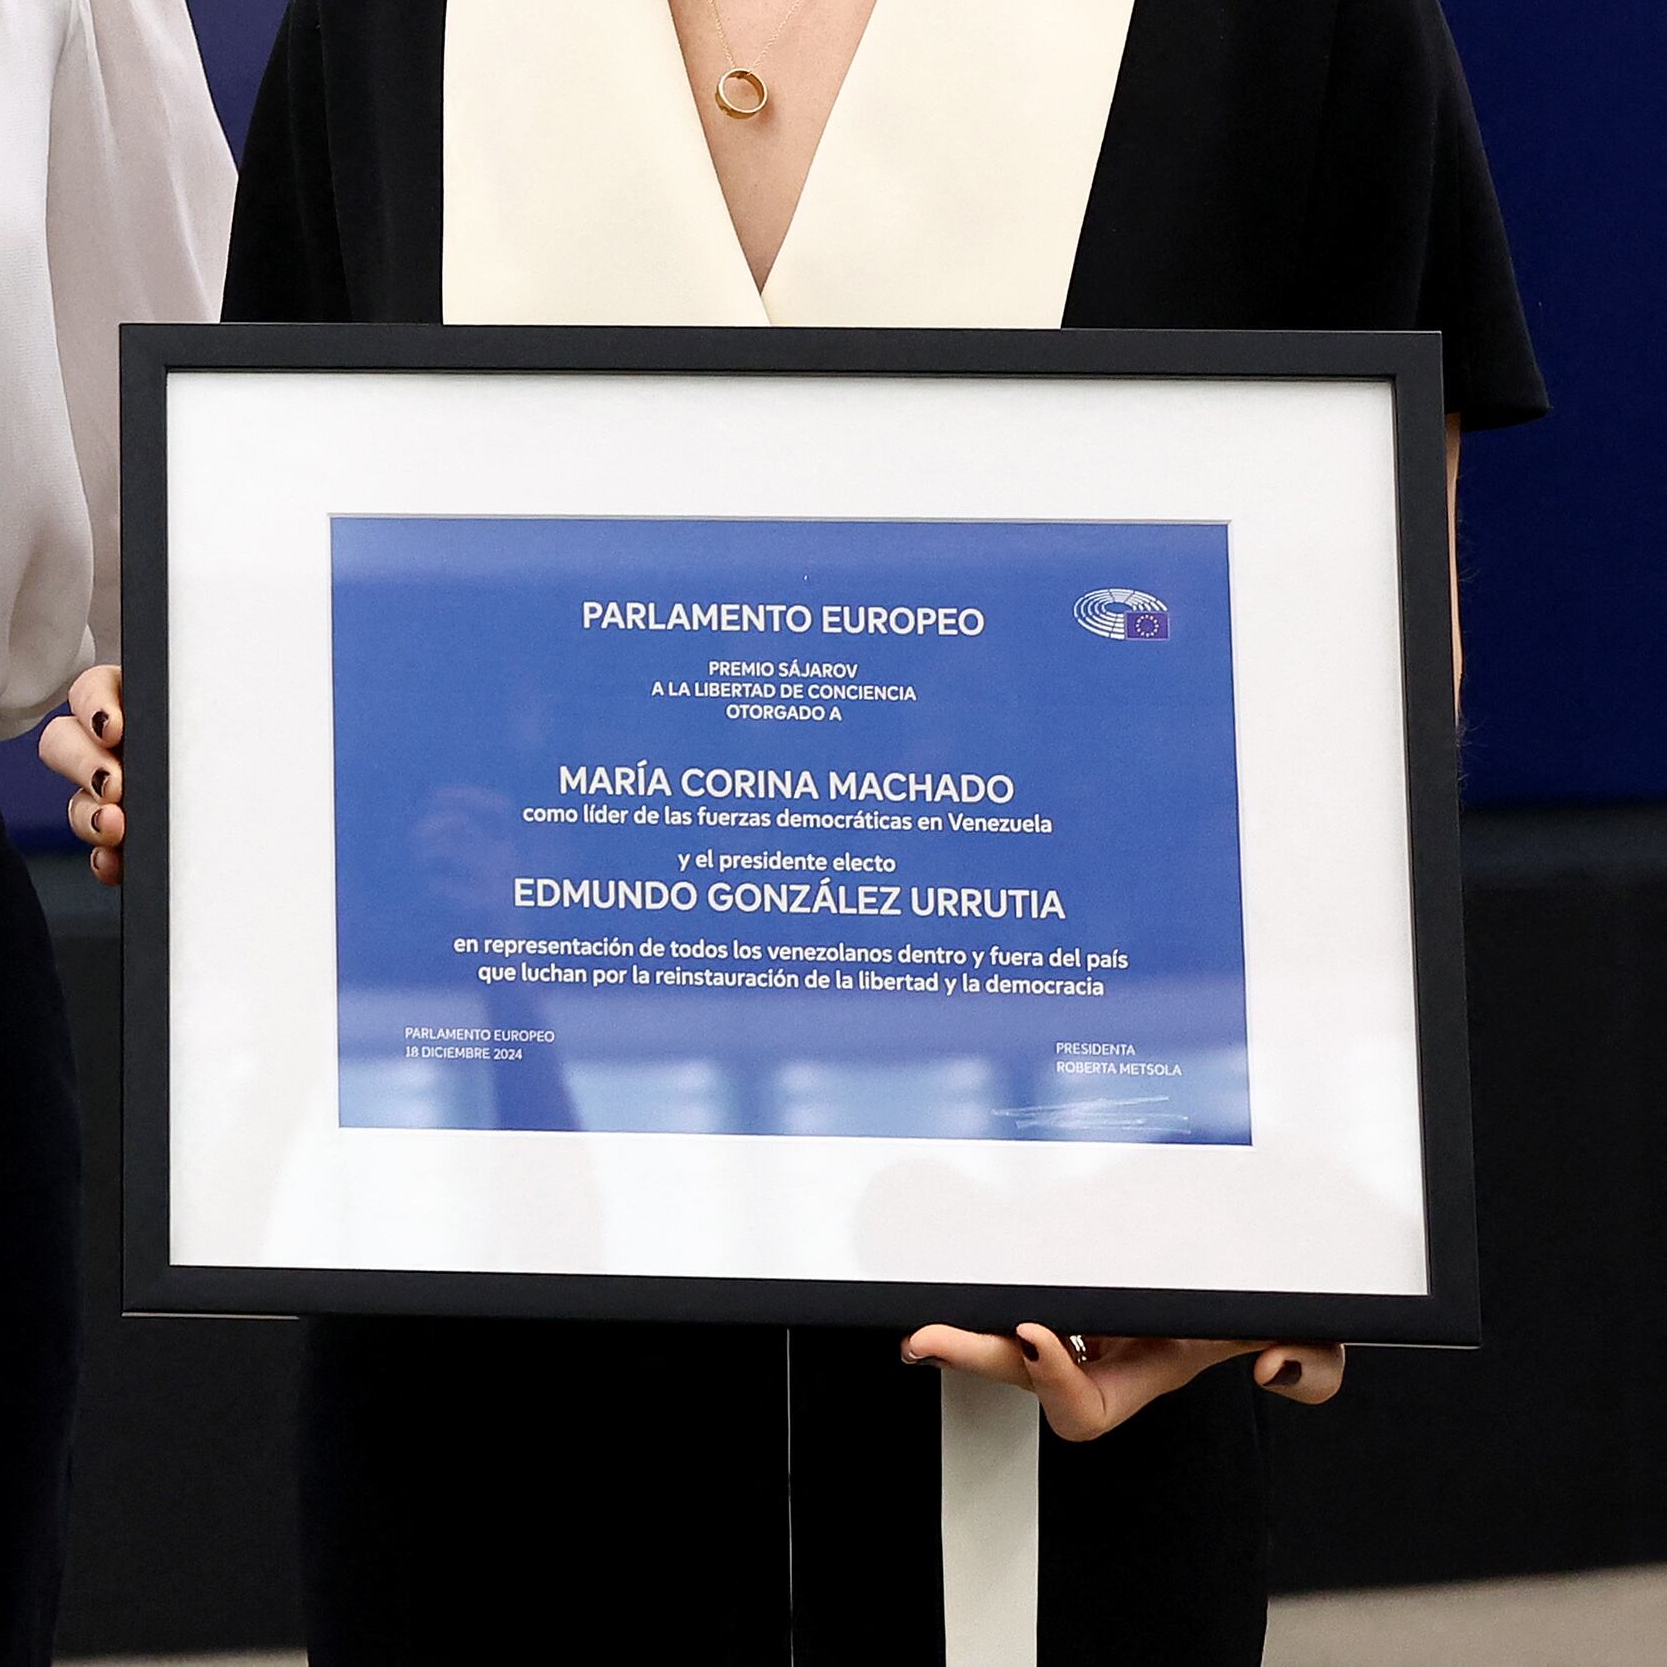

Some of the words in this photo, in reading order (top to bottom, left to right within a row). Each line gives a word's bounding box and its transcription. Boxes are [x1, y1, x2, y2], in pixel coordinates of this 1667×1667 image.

[582, 600, 812, 633] PARLAMENTO
[821, 604, 984, 636] EUROPEO
[708, 660, 774, 677] PREMIO
[777, 657, 858, 679] SÁJAROV
[650, 680, 665, 696] A
[667, 680, 691, 697] LA
[693, 681, 776, 698] LIBERTAD
[779, 682, 804, 699] DE
[807, 683, 917, 701] CONCIENCIA
[725, 703, 826, 721] OTORGADO
[828, 705, 842, 721] A
[558, 758, 672, 796] MARÍA
[680, 767, 819, 800] CORINA
[828, 770, 1014, 804] MACHADO
[522, 807, 578, 823] como
[582, 802, 629, 824] líder
[632, 804, 660, 825] de
[663, 804, 693, 825] las
[695, 805, 772, 827] fuerzas
[775, 807, 913, 830] democráticas
[916, 815, 943, 831] en
[947, 811, 1053, 833] Venezuela
[677, 852, 691, 872] y
[694, 848, 714, 868] el
[718, 849, 828, 873] presidente
[831, 851, 896, 873] electo
[513, 877, 698, 911] EDMUNDO
[706, 876, 902, 915] GONZÁLEZ
[910, 886, 1066, 919] URRUTIA
[452, 937, 478, 953] en
[483, 936, 634, 958] representación
[638, 936, 665, 957] de
[668, 937, 729, 959] todos
[732, 938, 763, 960] los
[766, 941, 893, 963] venezolanos
[896, 943, 967, 965] dentro
[971, 950, 985, 969] y
[988, 944, 1043, 967] fuera
[1048, 946, 1081, 967] del
[1086, 947, 1129, 972] país
[477, 965, 517, 985] que
[520, 961, 587, 983] luchan
[591, 968, 628, 987] por
[631, 963, 650, 984] la
[654, 965, 799, 988] reinstauración
[803, 968, 830, 989] de
[834, 969, 853, 989] la
[858, 969, 939, 992] libertad
[943, 976, 957, 996] y
[961, 972, 980, 992] la
[984, 973, 1104, 996] democracia
[404, 1026, 491, 1041] PARLAMENTO
[493, 1028, 555, 1043] EUROPEO
[421, 1045, 491, 1059] DICIEMBRE
[492, 1047, 523, 1060] 2024
[1055, 1041, 1136, 1056] PRESIDENTA
[1055, 1060, 1117, 1074] ROBERTA
[1118, 1062, 1182, 1076] METSOLA
